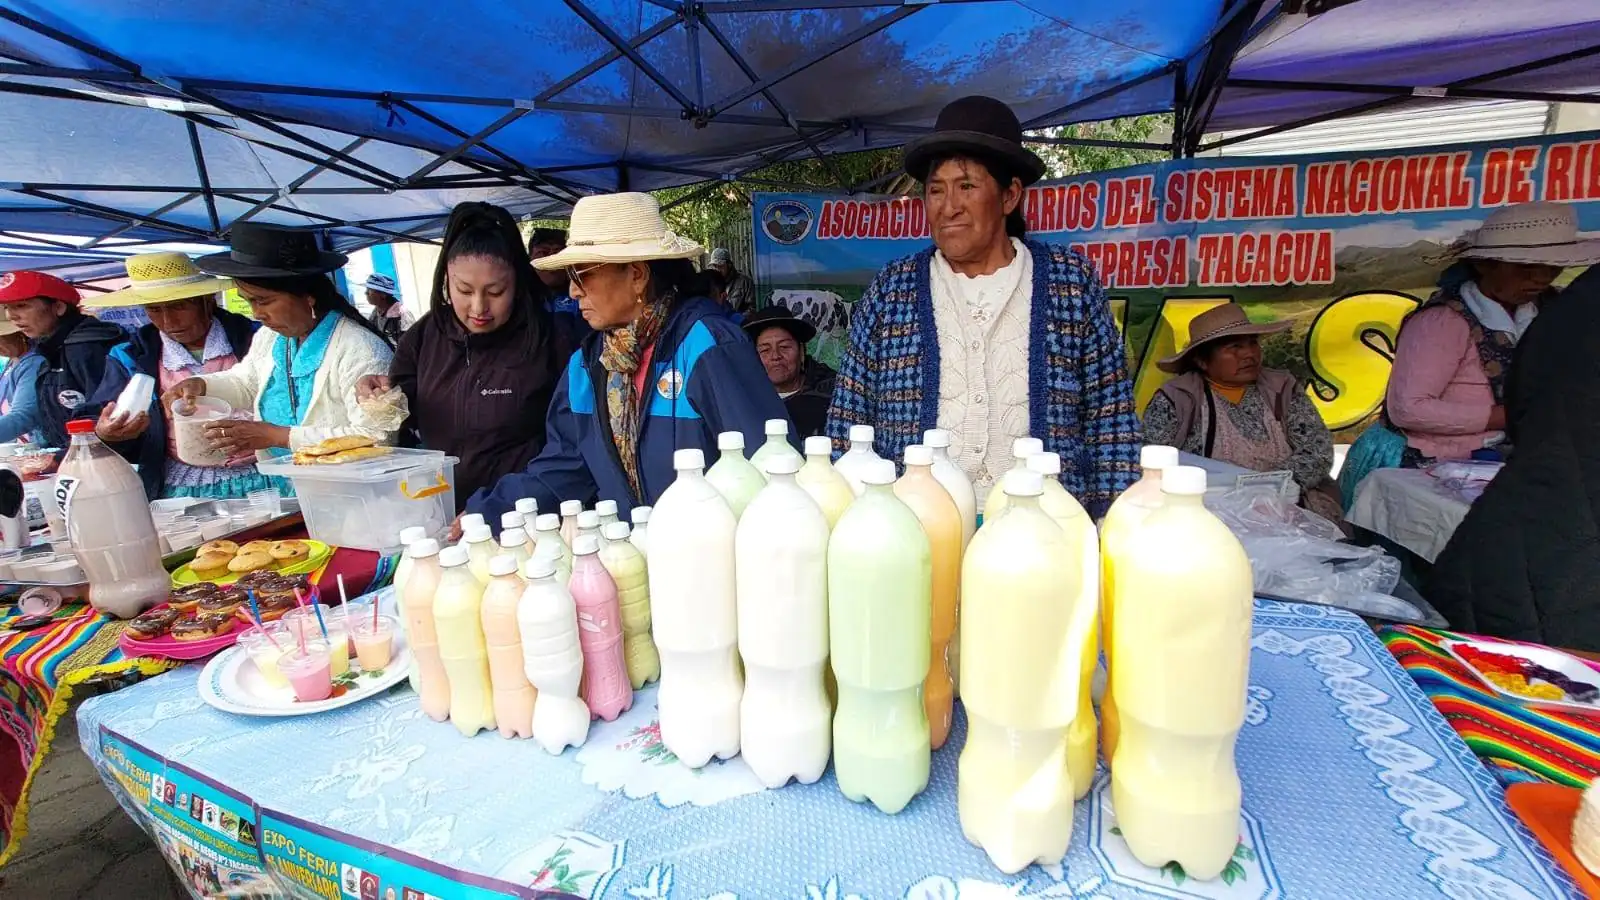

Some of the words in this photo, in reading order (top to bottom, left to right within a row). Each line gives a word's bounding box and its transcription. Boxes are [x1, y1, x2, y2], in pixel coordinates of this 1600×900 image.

[1025, 181, 1100, 233] ARIOS
[1104, 175, 1158, 228] DEL
[1164, 164, 1298, 223] SISTEMA
[1303, 151, 1473, 216] NACIONAL
[1479, 145, 1541, 208] DE
[1070, 236, 1190, 288] EPRESA
[1198, 229, 1335, 287] TACAGUA
[263, 829, 296, 856] EXPO
[299, 846, 338, 878] FERIA
